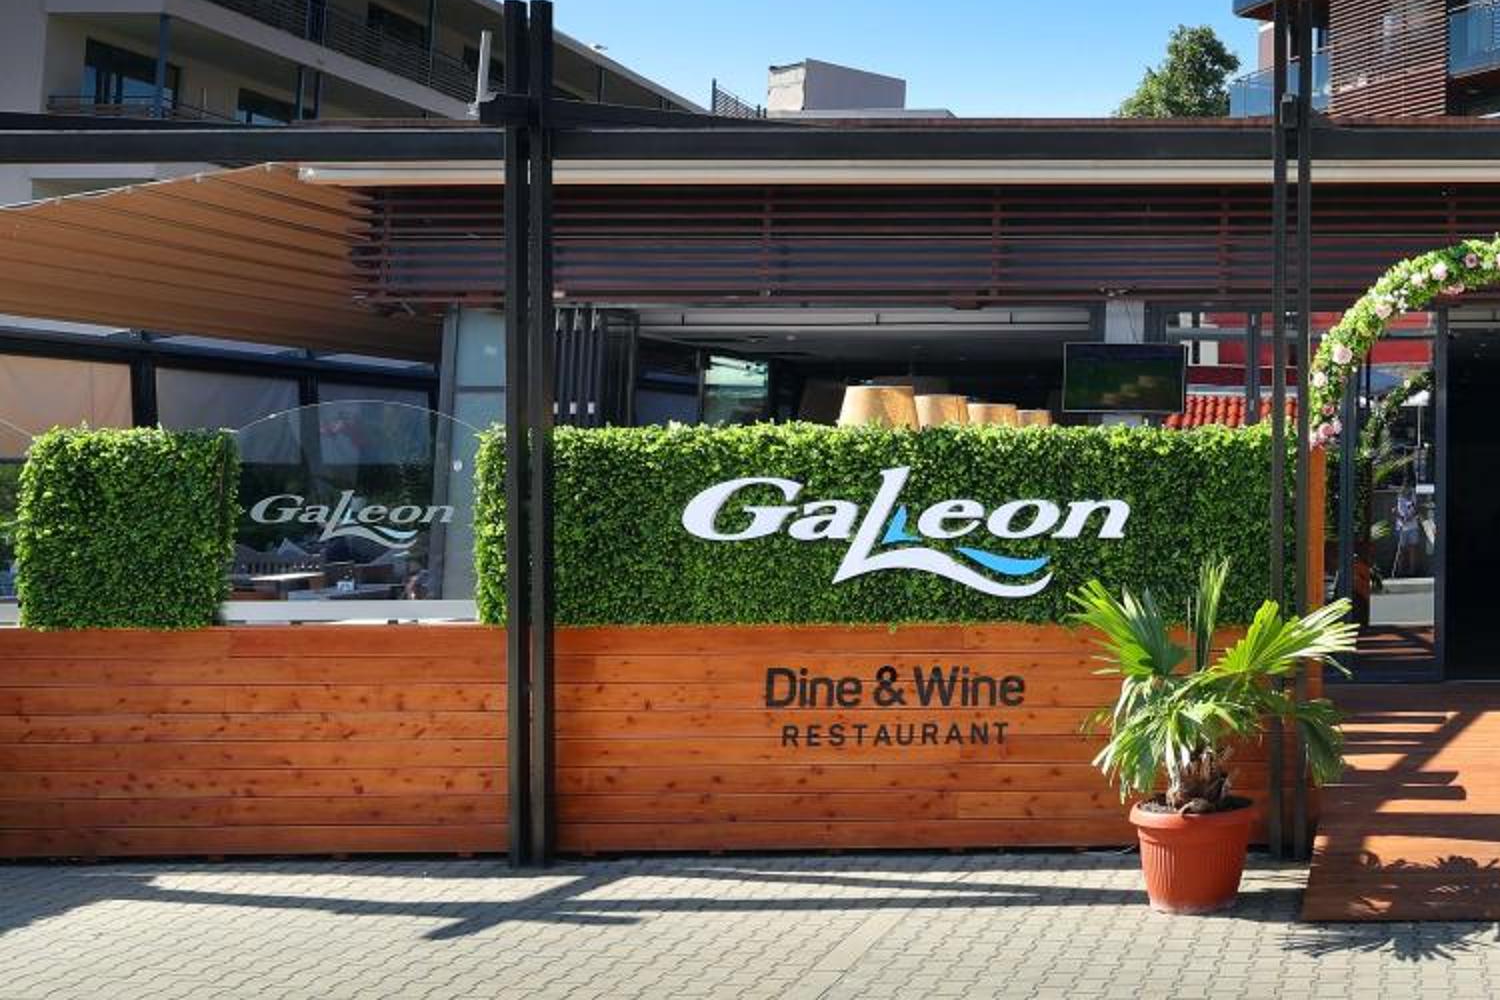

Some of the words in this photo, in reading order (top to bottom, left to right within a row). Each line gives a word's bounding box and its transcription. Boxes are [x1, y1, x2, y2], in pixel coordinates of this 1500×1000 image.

[765, 667, 863, 709] Dine
[872, 664, 906, 709] &
[913, 666, 1026, 707] Wine
[781, 722, 1009, 748] RESTAURANT
